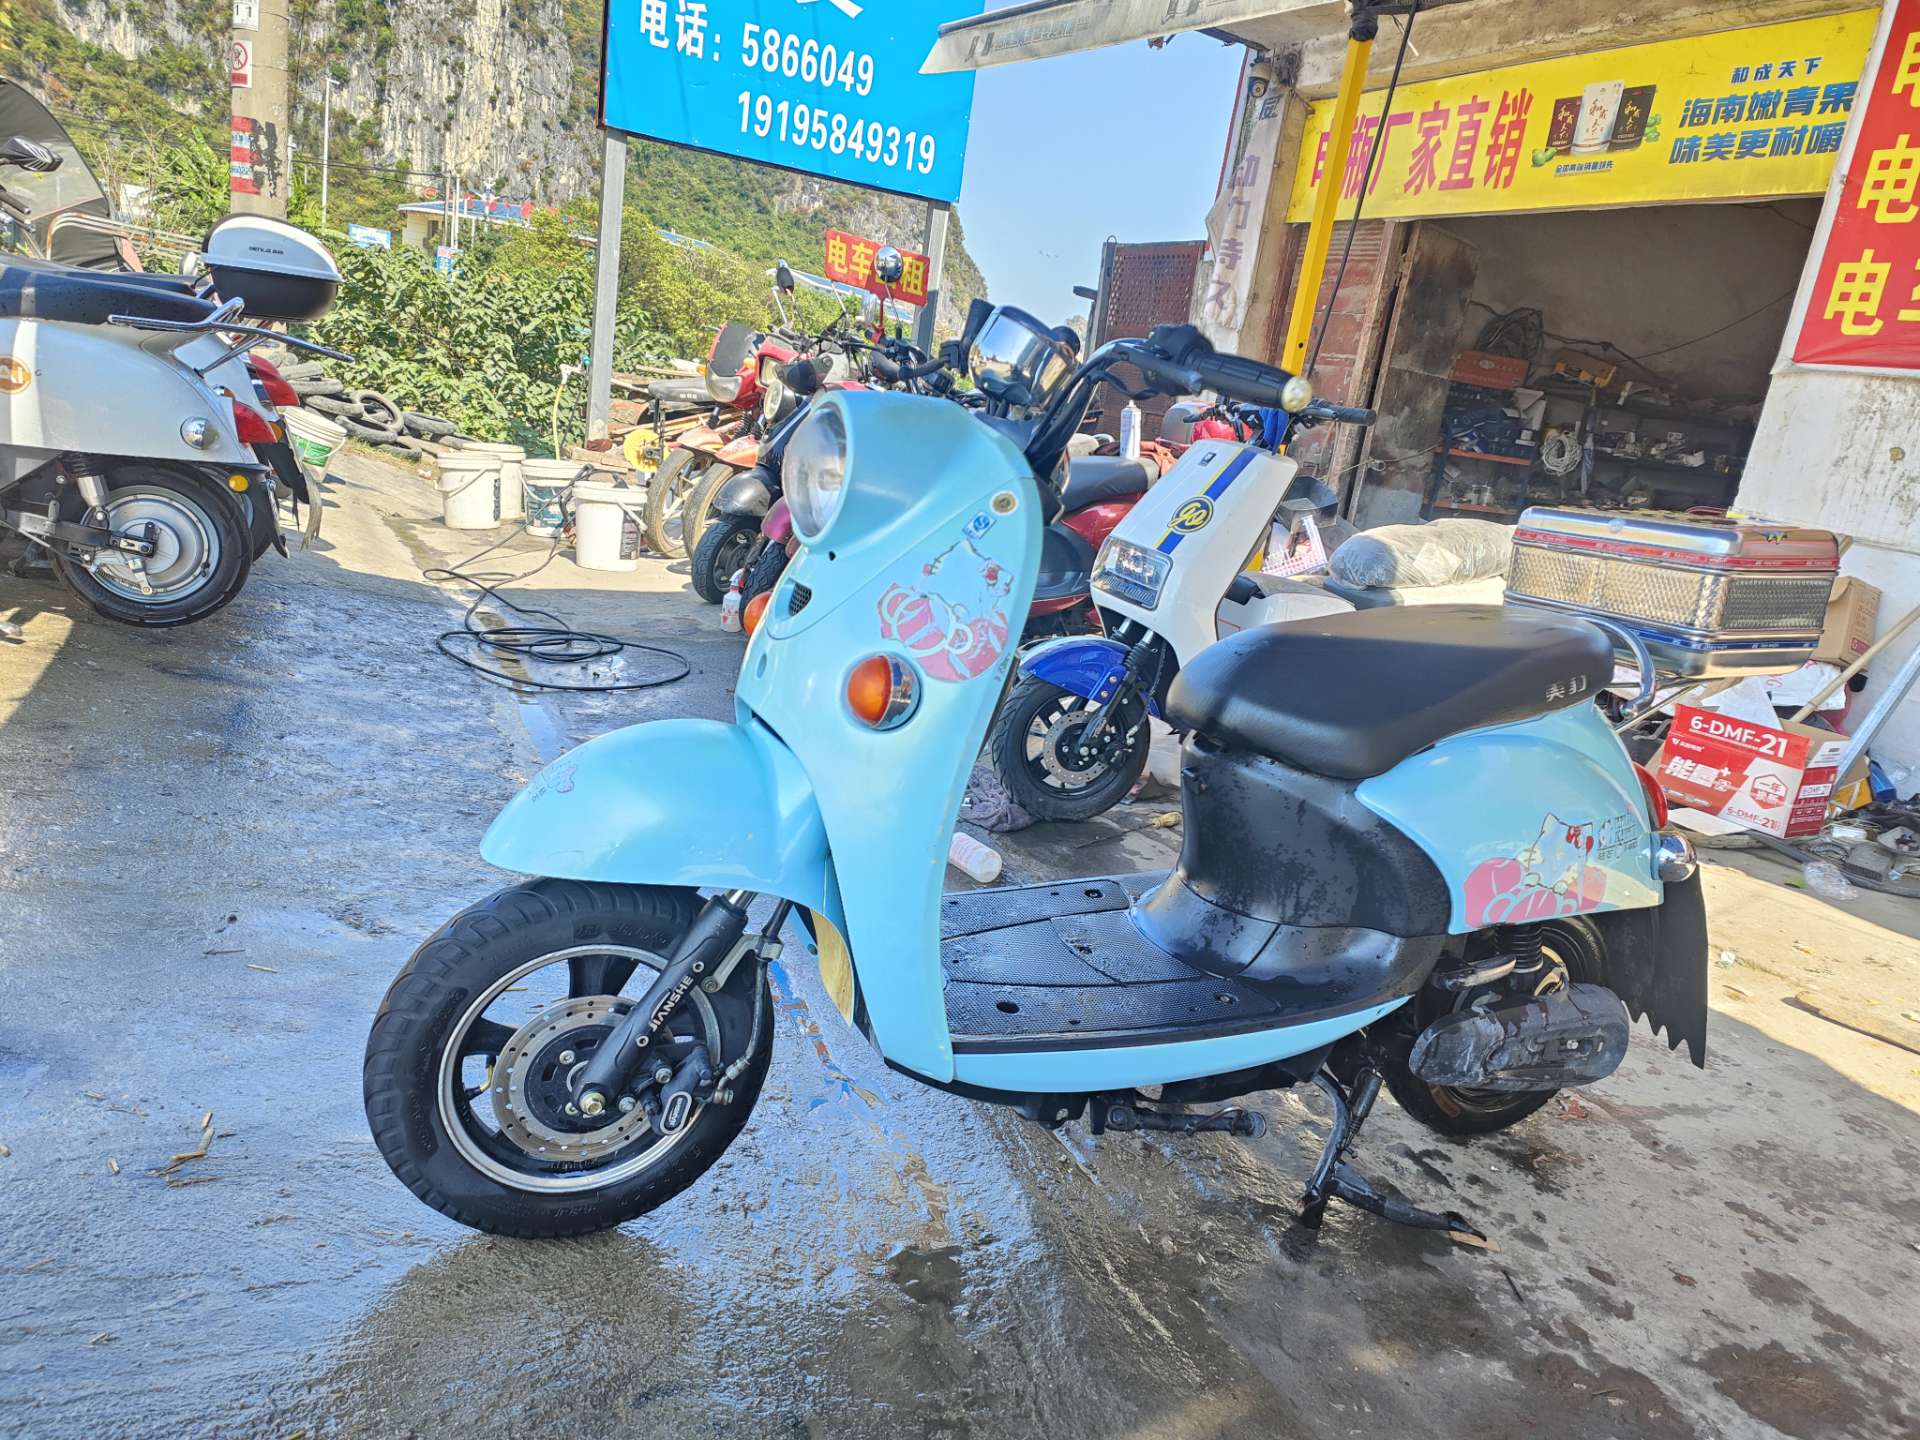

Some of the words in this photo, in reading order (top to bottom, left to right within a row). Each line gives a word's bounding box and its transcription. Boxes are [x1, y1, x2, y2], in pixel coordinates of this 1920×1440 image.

[742, 23, 874, 97] 5866049
[1730, 56, 1823, 84] 和成天下
[1679, 80, 1859, 128] 海南嫩青果
[738, 91, 936, 175] 19195849319
[1668, 121, 1847, 165] 味美更耐嚼
[828, 235, 924, 296] 电车租
[1823, 248, 1920, 337] 电
[1689, 714, 1789, 759] 6-DMF-21
[1727, 806, 1777, 830] 6-DMF-21
[648, 975, 694, 1033] JIANSHE
